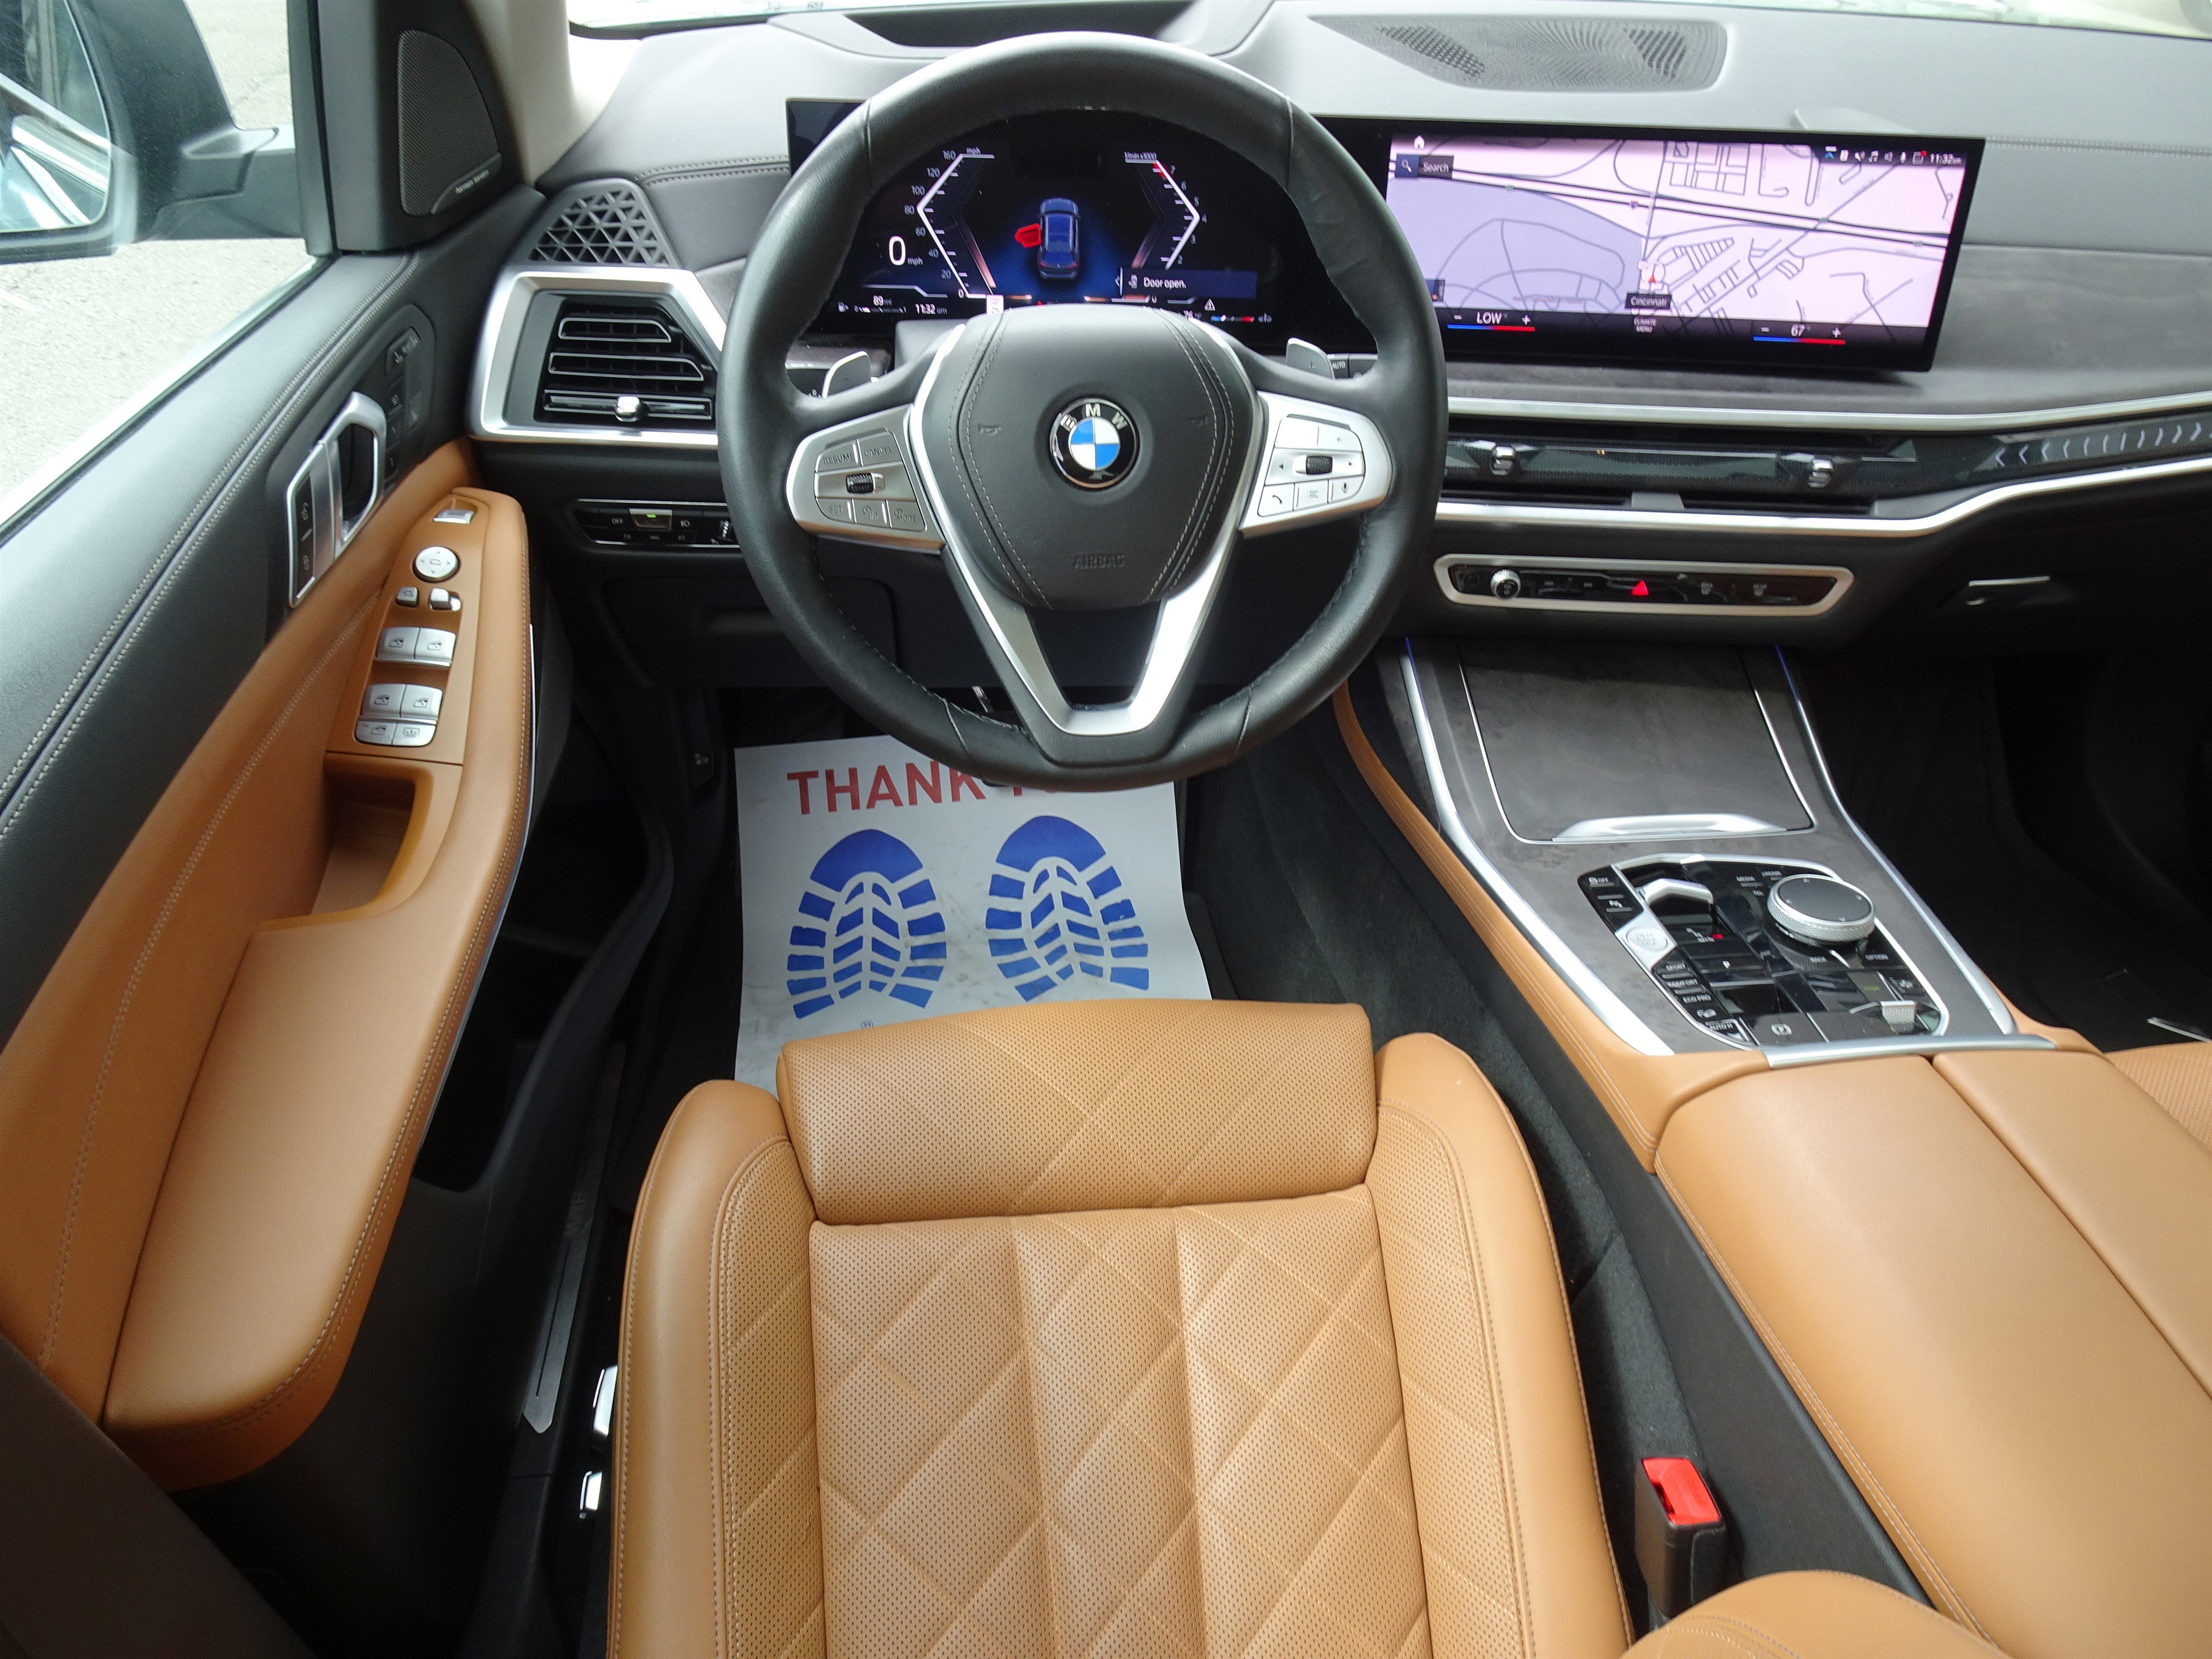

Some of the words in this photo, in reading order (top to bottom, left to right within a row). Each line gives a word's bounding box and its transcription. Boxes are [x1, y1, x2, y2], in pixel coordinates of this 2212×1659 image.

[942, 150, 956, 160] 160
[966, 147, 981, 155] mph
[1930, 153, 1953, 164] 11:32
[1422, 161, 1449, 173] Search
[926, 167, 940, 178] 120
[911, 185, 925, 195] 100
[1181, 181, 1186, 191] 6
[904, 205, 915, 215] 80
[915, 227, 926, 237] 60
[889, 235, 906, 266] 0
[907, 257, 923, 266] mph
[928, 248, 939, 258] 40
[941, 269, 952, 279] 20
[1143, 276, 1163, 288] Door
[1164, 278, 1186, 289] open.
[958, 288, 965, 299] 0
[873, 295, 884, 306] 89
[915, 304, 935, 314] 11:32
[1476, 311, 1502, 324] LOW
[1636, 325, 1653, 333] MENU
[1791, 324, 1805, 336] 67
[1332, 360, 1346, 369] AUTO
[1060, 403, 1128, 431] BMW
[864, 446, 892, 458] CANCEL
[823, 453, 854, 466] RESUME
[828, 505, 844, 514] SET
[1074, 555, 1125, 569] AIRBAG
[787, 760, 987, 814] THANK
[1665, 963, 1686, 971] SPORT
[1668, 978, 1698, 988] COMFORT
[1683, 995, 1697, 1004] ECO
[1697, 994, 1711, 1002] PRO
